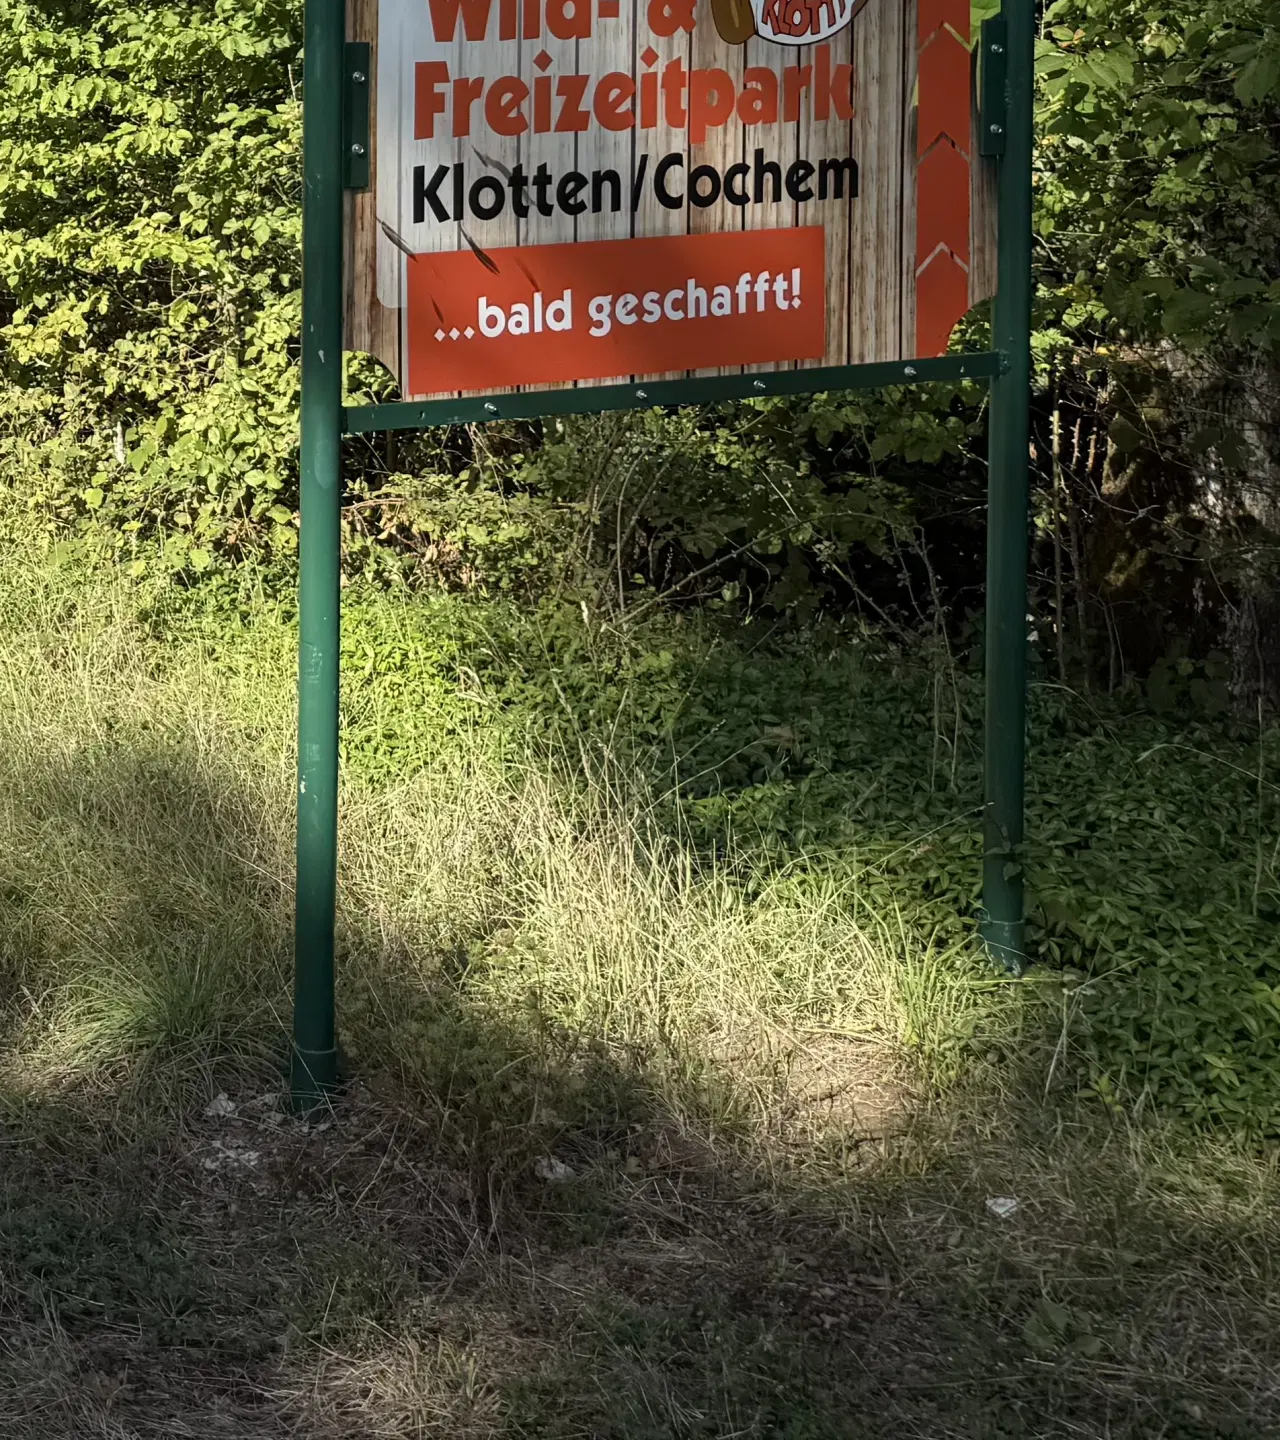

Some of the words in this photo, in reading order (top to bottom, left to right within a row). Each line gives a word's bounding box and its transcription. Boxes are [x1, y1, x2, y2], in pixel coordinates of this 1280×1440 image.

[413, 44, 855, 144] Freizeitpark
[412, 151, 859, 224] Klotten/Cochem
[434, 288, 573, 342] ...bald
[588, 267, 802, 337] geschafft!
